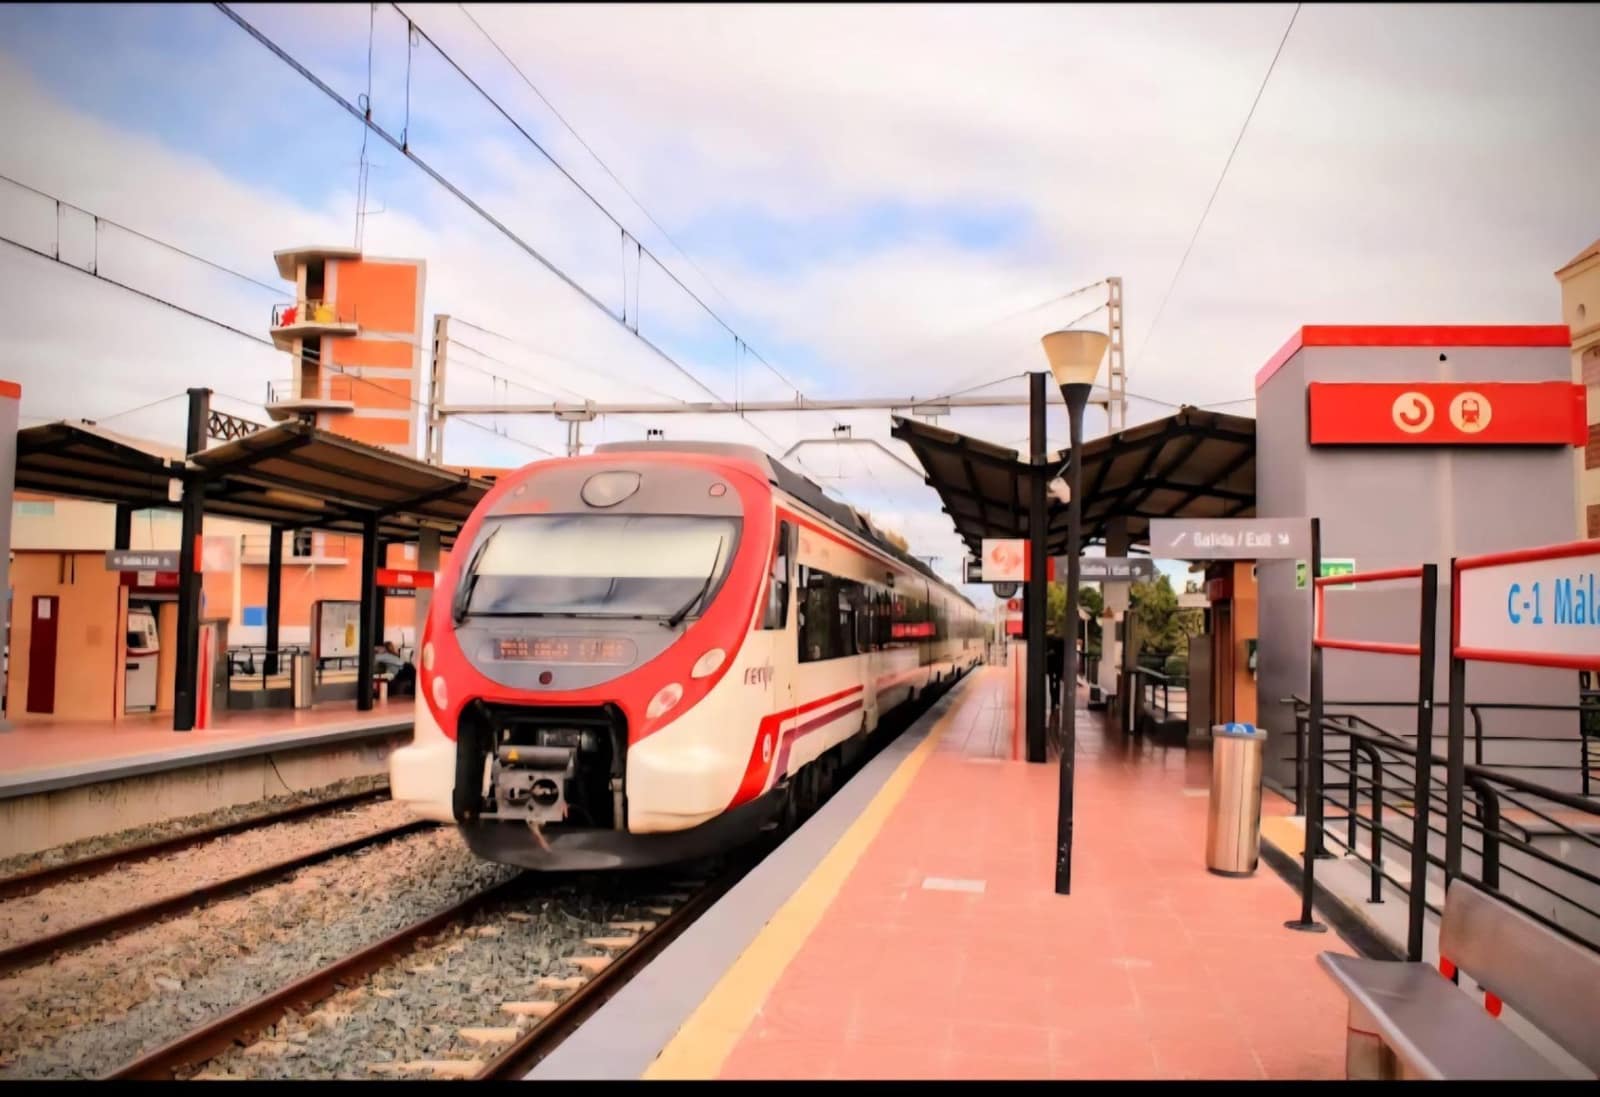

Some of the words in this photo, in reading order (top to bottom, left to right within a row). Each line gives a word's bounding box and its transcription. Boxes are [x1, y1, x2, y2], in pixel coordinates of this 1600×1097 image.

[1245, 531, 1271, 547] Exit
[1508, 582, 1543, 624] C-1
[1554, 573, 1600, 624] Mál
